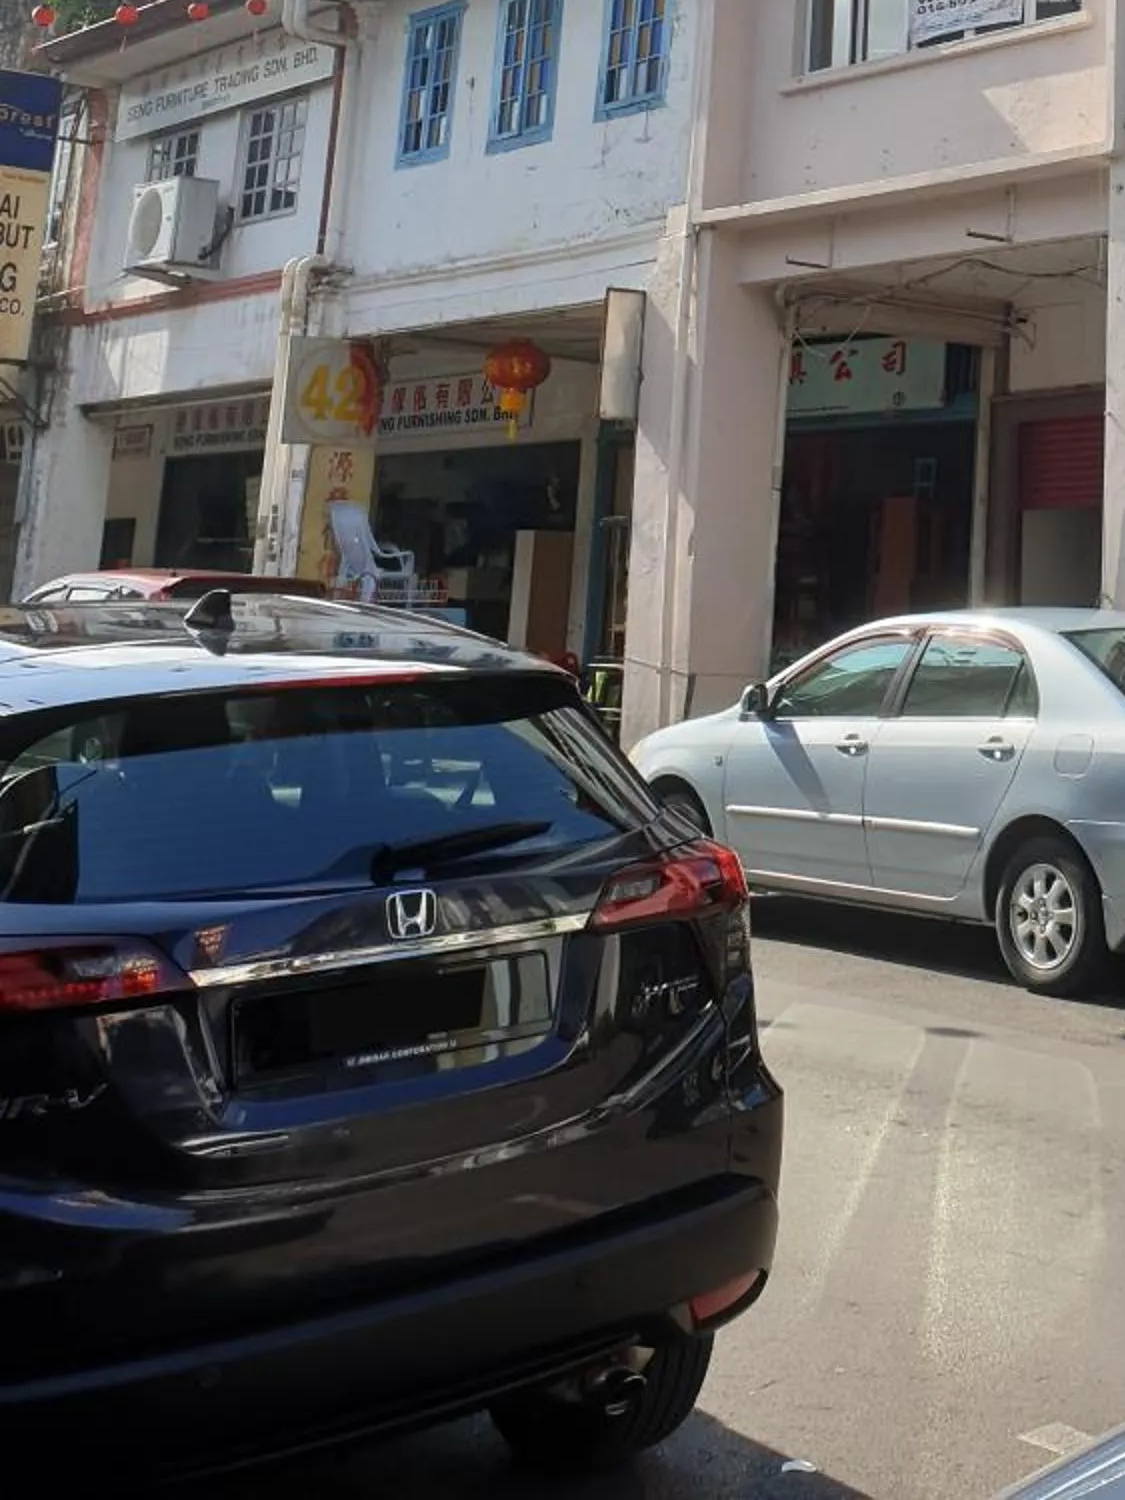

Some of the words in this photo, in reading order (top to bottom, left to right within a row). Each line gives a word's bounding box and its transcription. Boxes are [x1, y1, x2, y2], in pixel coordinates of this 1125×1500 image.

[155, 81, 208, 112] FURNITURE
[214, 65, 259, 94] TRADING
[0, 194, 20, 219] AI
[302, 363, 367, 421] 42
[396, 410, 462, 430] FURNISHING
